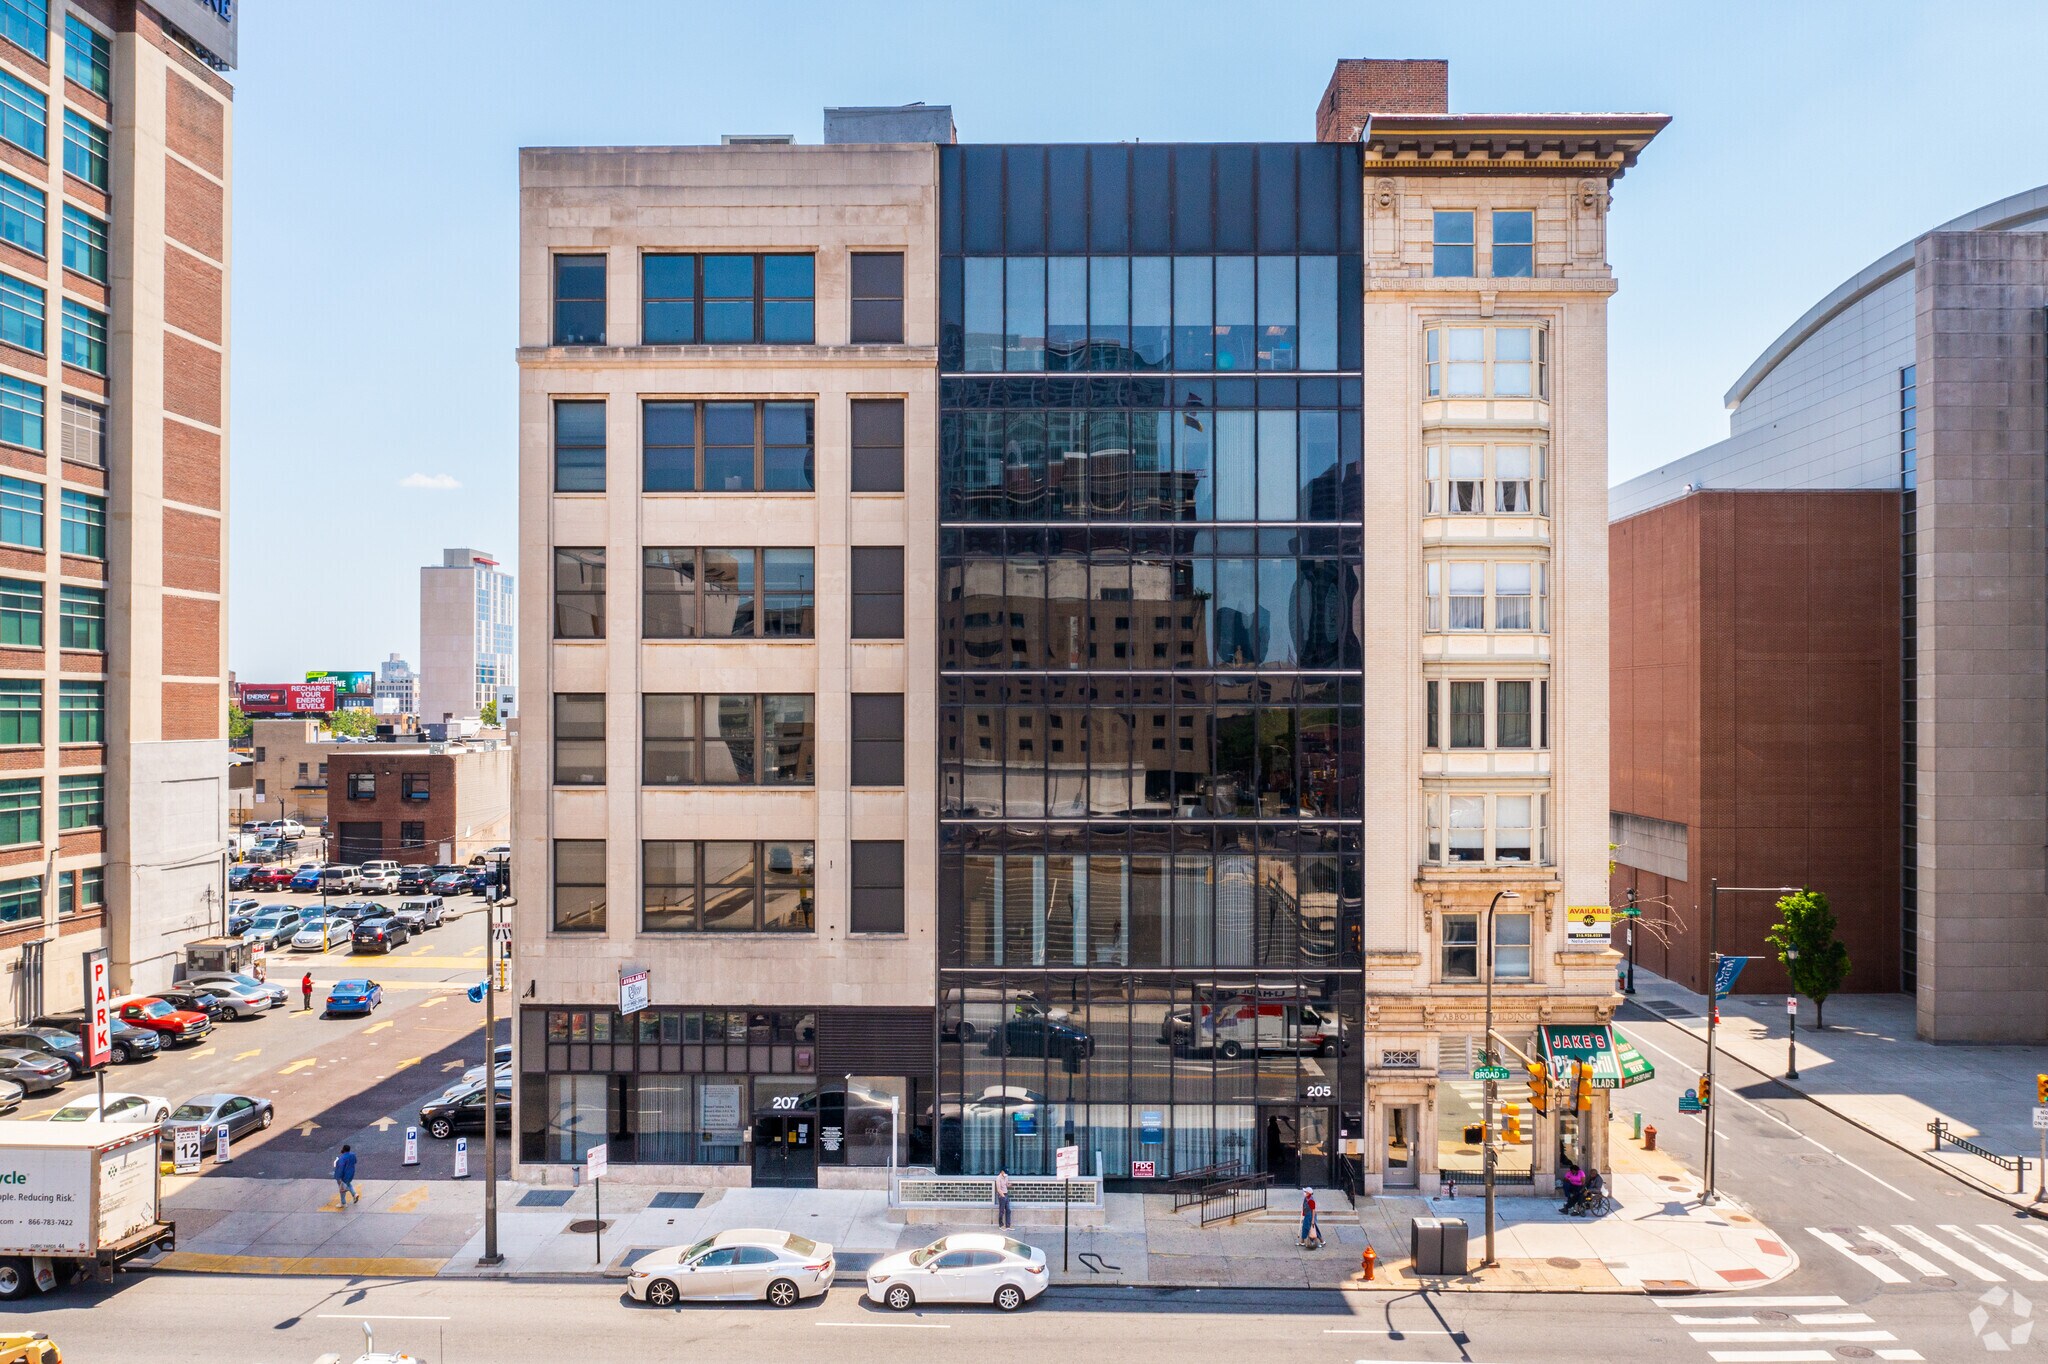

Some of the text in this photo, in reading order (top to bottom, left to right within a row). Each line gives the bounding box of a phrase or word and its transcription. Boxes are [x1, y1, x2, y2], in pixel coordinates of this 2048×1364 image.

[246, 693, 270, 701] ENERGY
[623, 973, 646, 985] AVAILABLE
[95, 964, 108, 1049] PARK
[1442, 1012, 1532, 1021] ABBOTT VILDING
[1553, 1032, 1606, 1048] JAKE'S
[1474, 1071, 1500, 1079] BROAD
[1592, 1079, 1615, 1088] ALADS
[1307, 1085, 1331, 1097] 205
[773, 1096, 799, 1109] 207
[18, 1193, 54, 1203] Reducing
[28, 1218, 73, 1226] 866-783-7422
